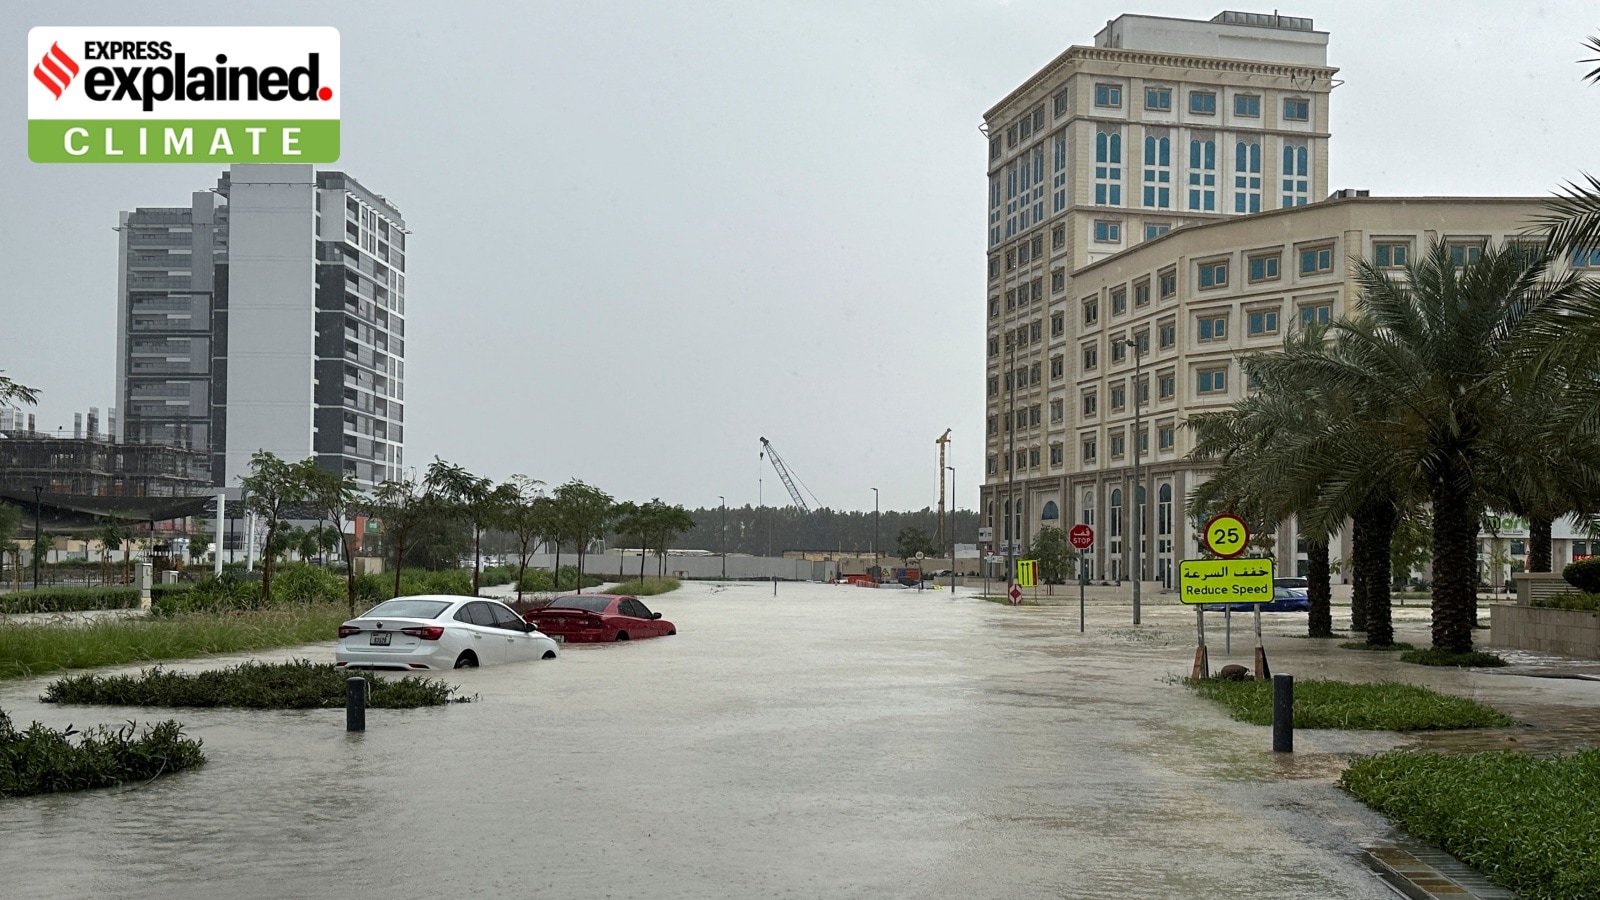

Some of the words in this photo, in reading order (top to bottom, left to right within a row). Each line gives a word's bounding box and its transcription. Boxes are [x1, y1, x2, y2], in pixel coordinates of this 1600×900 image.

[1073, 528, 1090, 536] قف
[1214, 528, 1239, 545] 25
[1184, 566, 1228, 581] السرعة
[1233, 566, 1269, 577] خفف
[1186, 585, 1228, 595] Reduce
[1232, 584, 1268, 596] Speed
